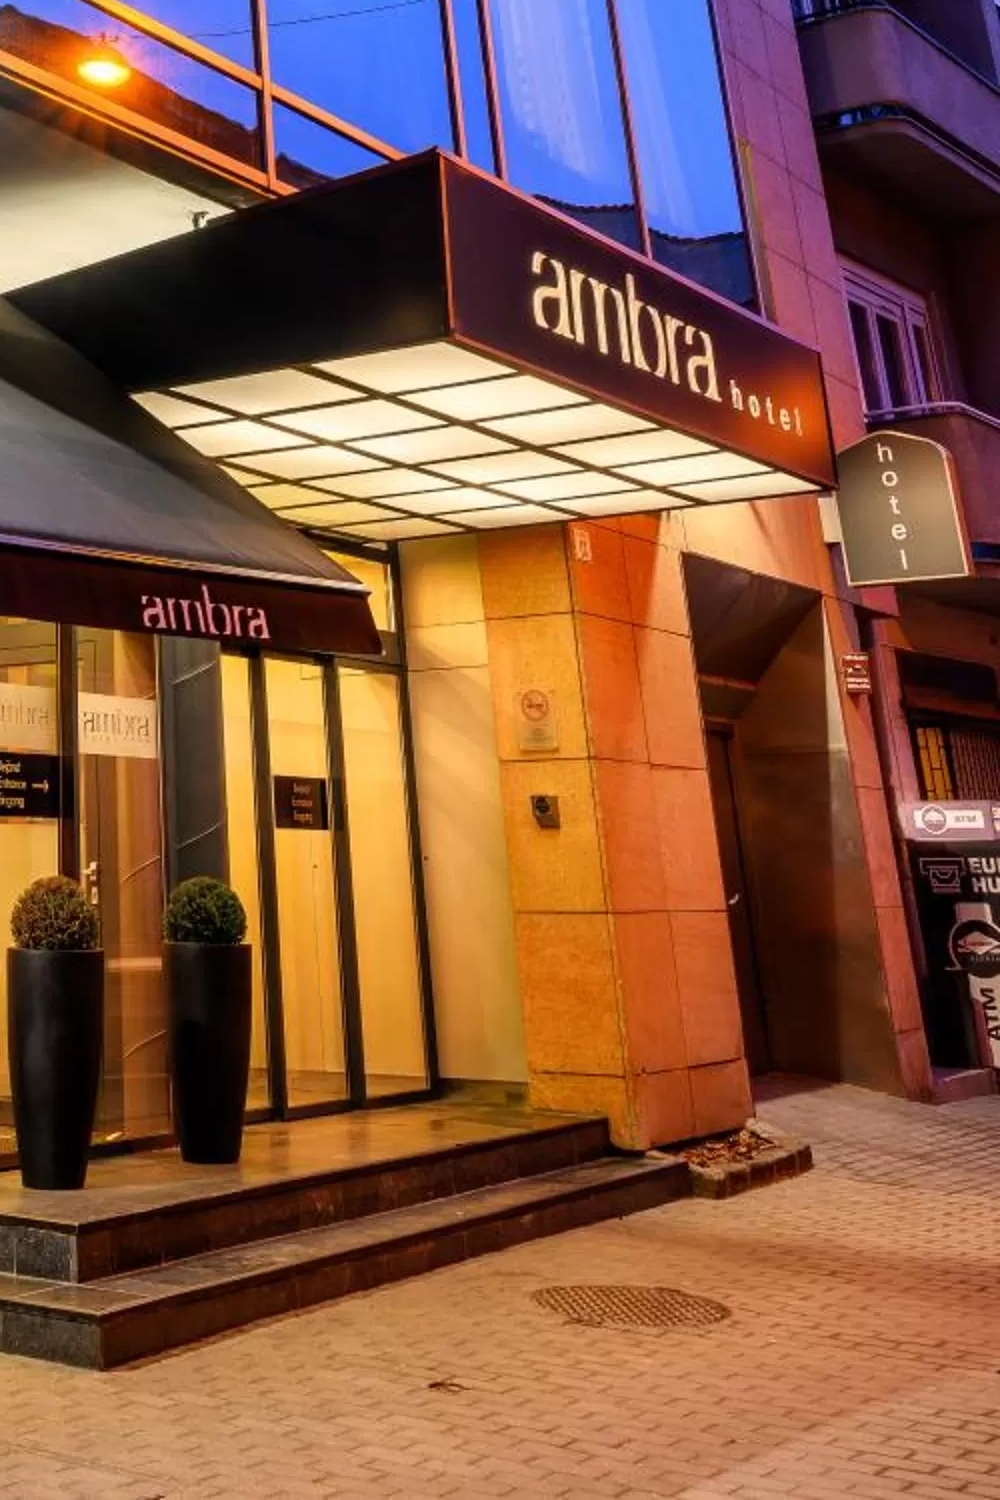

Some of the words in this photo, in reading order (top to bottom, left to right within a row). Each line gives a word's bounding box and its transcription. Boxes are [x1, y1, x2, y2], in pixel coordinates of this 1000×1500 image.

[531, 251, 723, 402] ambra
[730, 380, 803, 437] hotel
[875, 442, 909, 571] hotel
[140, 583, 271, 639] ambra
